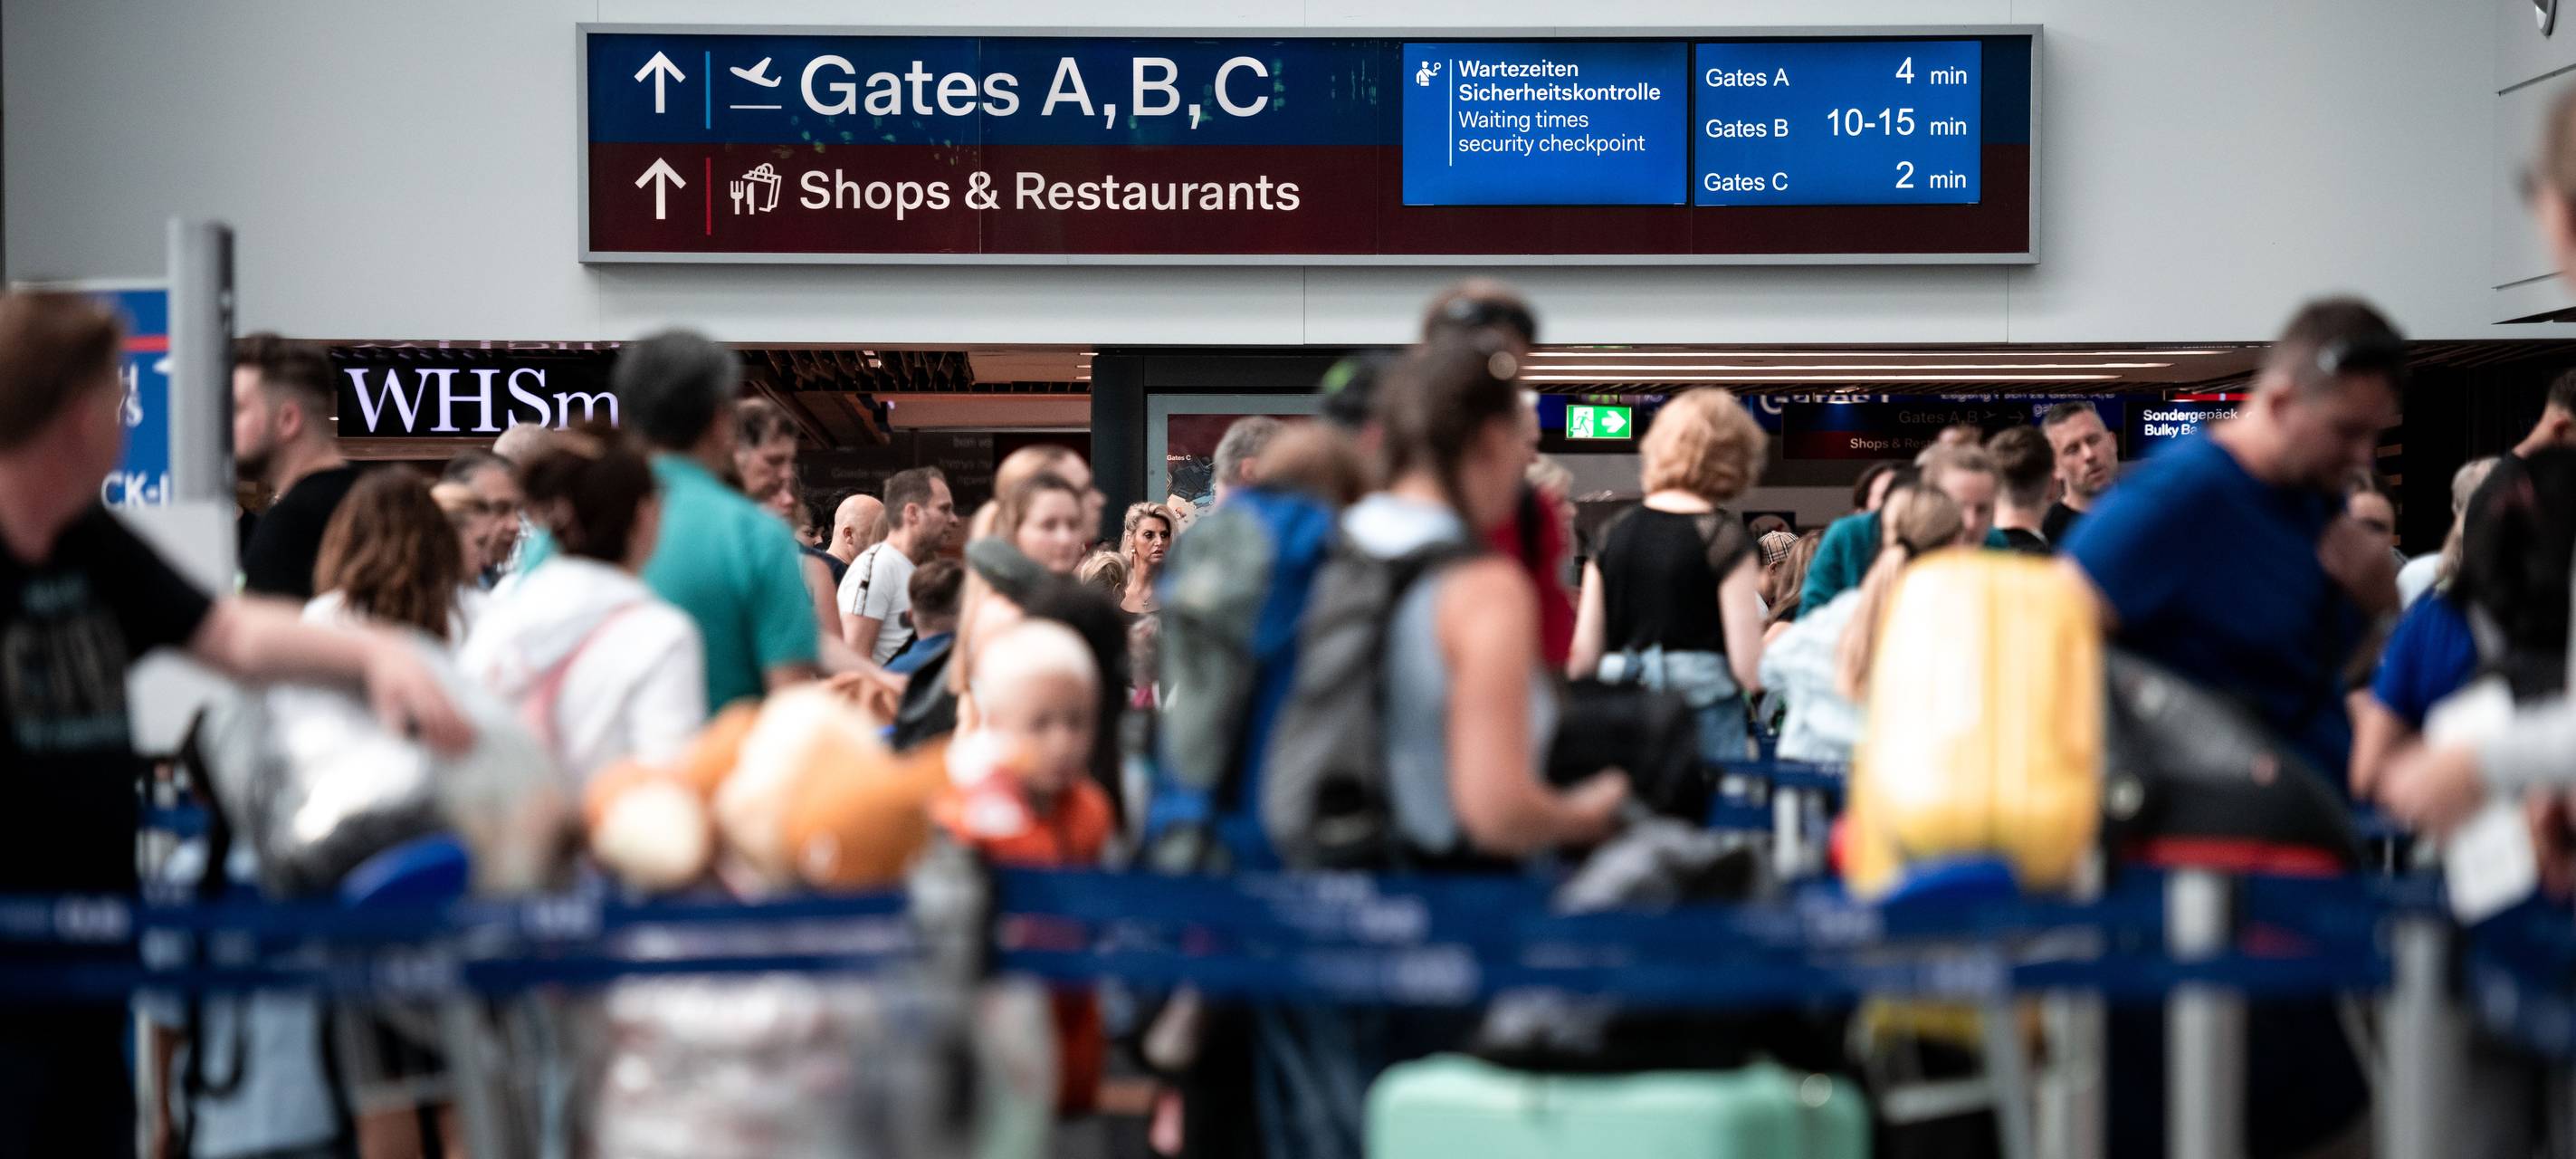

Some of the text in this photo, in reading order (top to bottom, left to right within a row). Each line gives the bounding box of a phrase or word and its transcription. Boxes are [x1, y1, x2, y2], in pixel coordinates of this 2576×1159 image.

[1458, 59, 1579, 78] Wartezeiten
[1705, 56, 1967, 87] Gates A 4 min
[800, 54, 1269, 129] Gates A,B,C
[1458, 82, 1661, 101] Sicherheitskontrolle
[1458, 110, 1589, 131] Waiting times
[1705, 108, 1967, 138] Gates B 10-15 min
[1458, 133, 1646, 157] security checkpoint
[1704, 160, 1967, 192] Gates C 2 min
[800, 168, 1301, 221] Shops & Restaurants
[343, 367, 620, 433] WHSm
[1898, 409, 1945, 424] Gates
[2142, 407, 2238, 423] Sondergepäck
[2144, 423, 2179, 438] Bulky
[1849, 437, 1889, 452] Shops
[1892, 437, 1901, 449] &
[100, 470, 169, 512] CK-I
